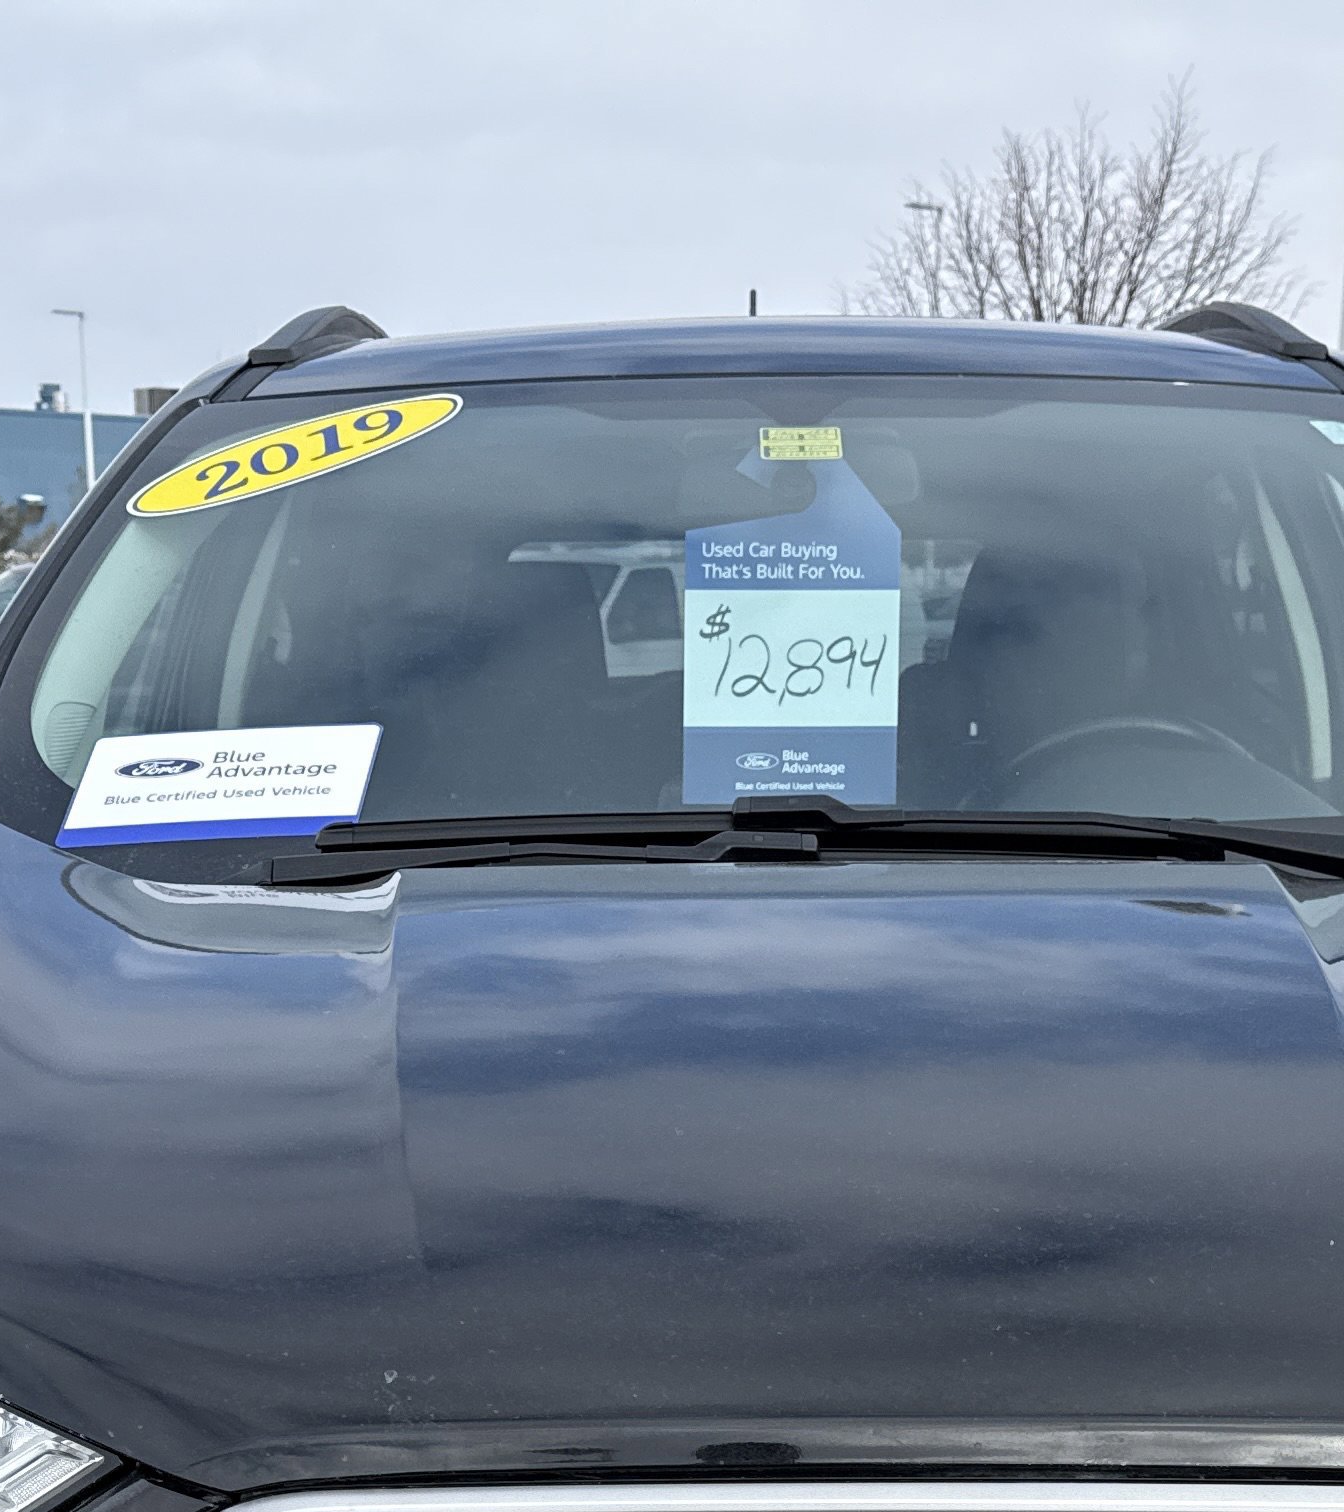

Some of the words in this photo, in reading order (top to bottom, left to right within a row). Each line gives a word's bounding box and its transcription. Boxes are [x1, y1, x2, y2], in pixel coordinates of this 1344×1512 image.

[195, 408, 404, 501] 2019
[701, 541, 744, 558] Used
[748, 541, 776, 558] Car
[780, 540, 838, 561] Buying
[701, 562, 752, 579] That's
[756, 562, 794, 579] Built
[798, 563, 826, 579] For
[829, 563, 865, 579] You.
[212, 750, 266, 764] Blue
[782, 749, 810, 761] Blue
[206, 761, 338, 779] Advantage
[781, 762, 846, 775] Advantage
[104, 795, 141, 805] Blue
[146, 788, 217, 803] Certified
[223, 787, 265, 799] Used
[272, 784, 332, 797] Vehicle
[735, 781, 754, 791] Blue
[756, 781, 791, 791] Certified
[792, 781, 814, 791] Used
[816, 781, 846, 791] Vehicle
